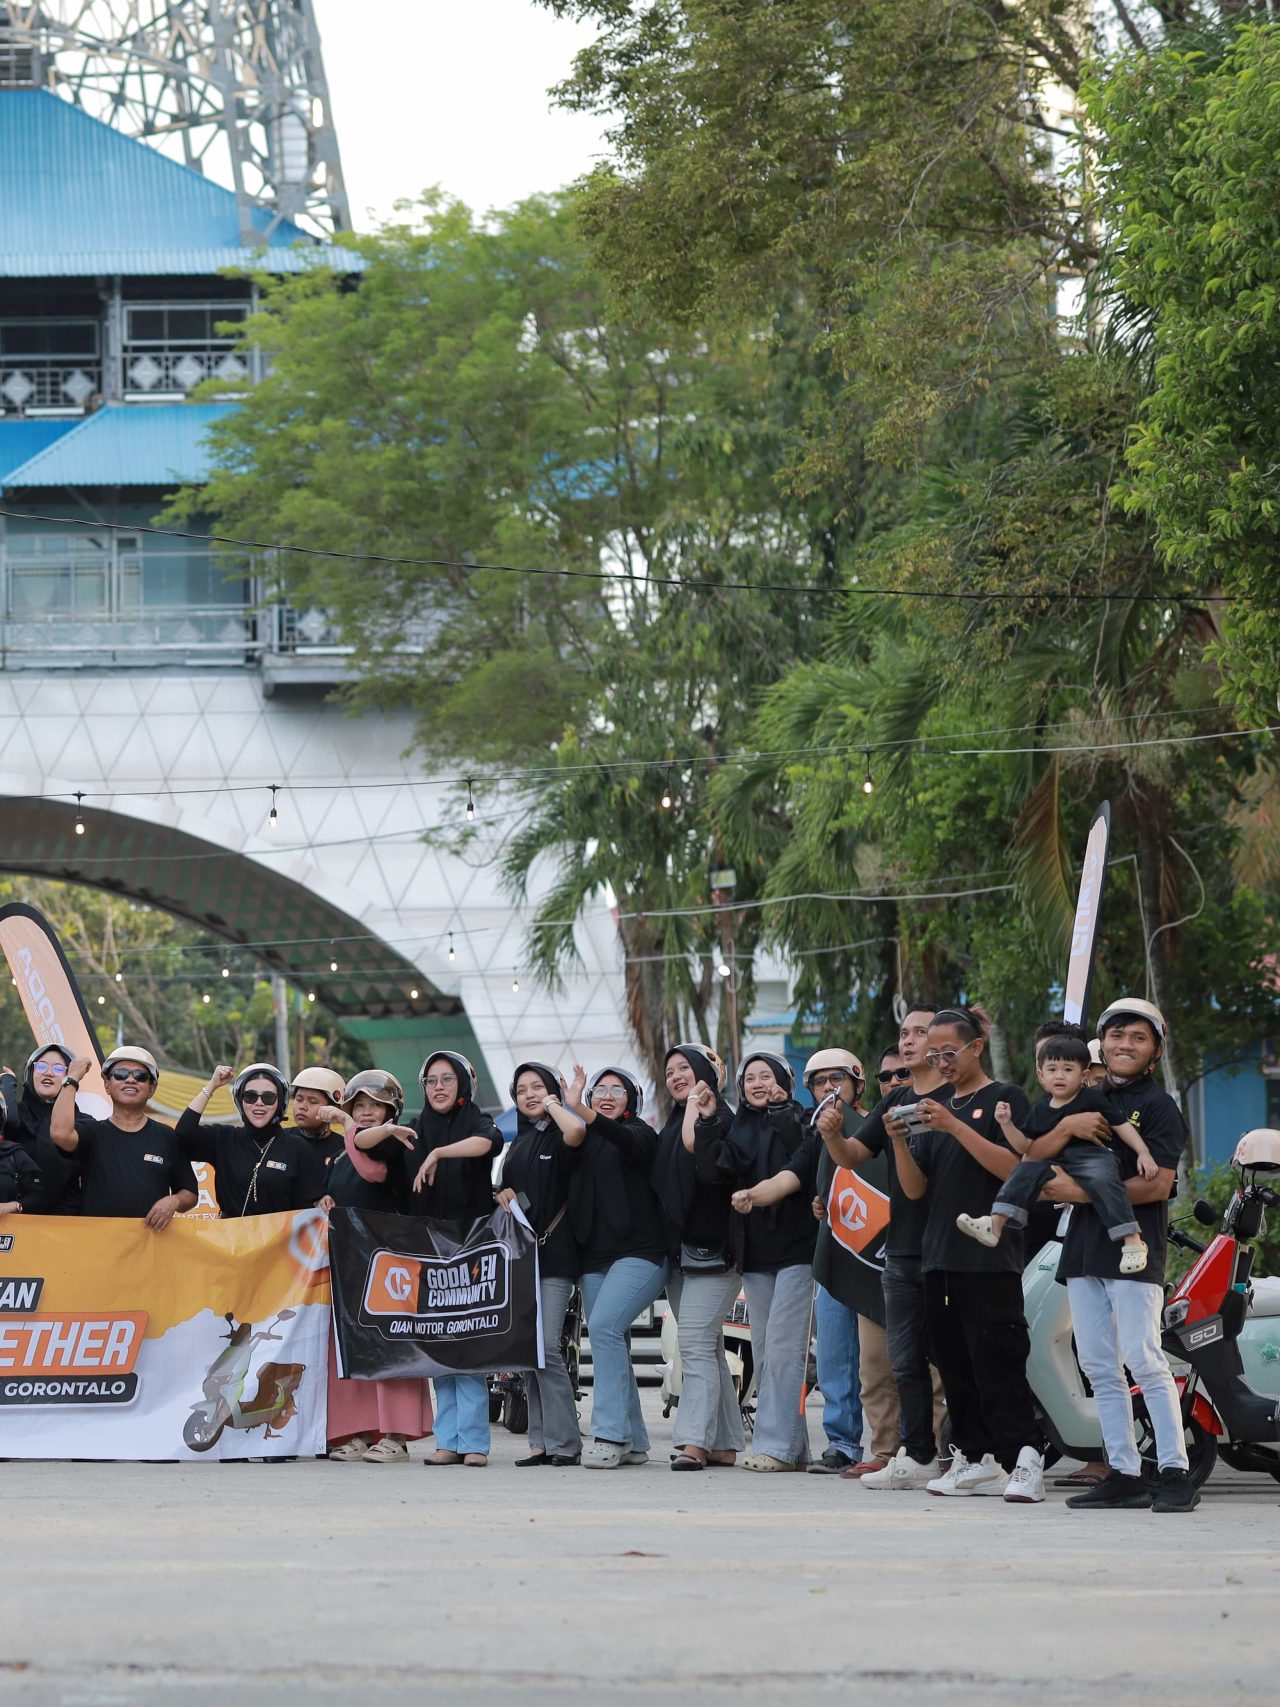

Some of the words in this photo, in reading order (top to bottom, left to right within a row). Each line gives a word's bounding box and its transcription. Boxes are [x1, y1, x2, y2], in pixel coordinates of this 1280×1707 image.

[427, 1263, 471, 1290] GODA
[389, 1320, 413, 1334] QIAN
[414, 1321, 444, 1334] MOTOR
[446, 1314, 499, 1335] GORONTALO
[4, 1381, 127, 1397] GORONTALO
